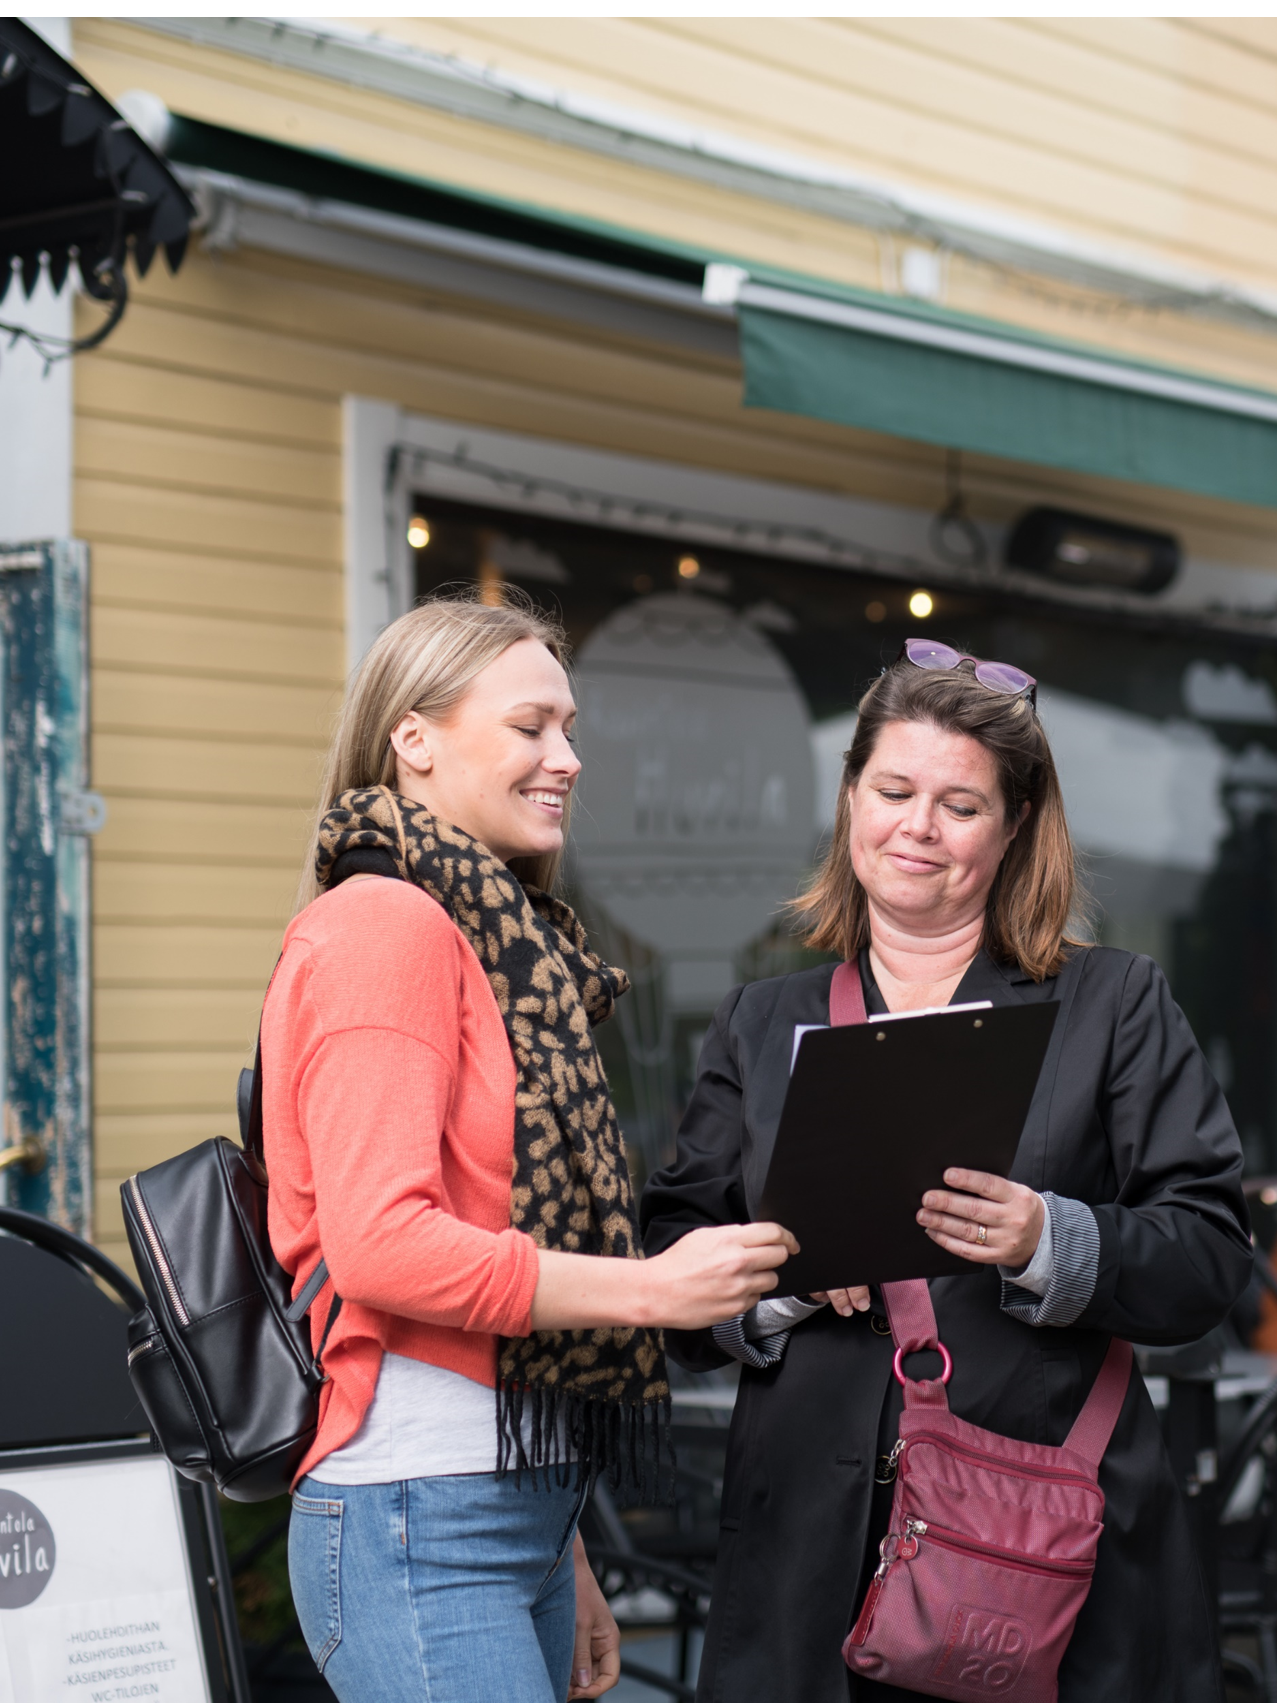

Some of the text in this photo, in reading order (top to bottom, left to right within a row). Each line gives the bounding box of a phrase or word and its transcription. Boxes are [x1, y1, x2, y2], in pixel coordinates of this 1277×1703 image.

[961, 1612, 1023, 1656] MD
[959, 1654, 1013, 1686] 20
[91, 1682, 159, 1703] WC-TILOJEN
